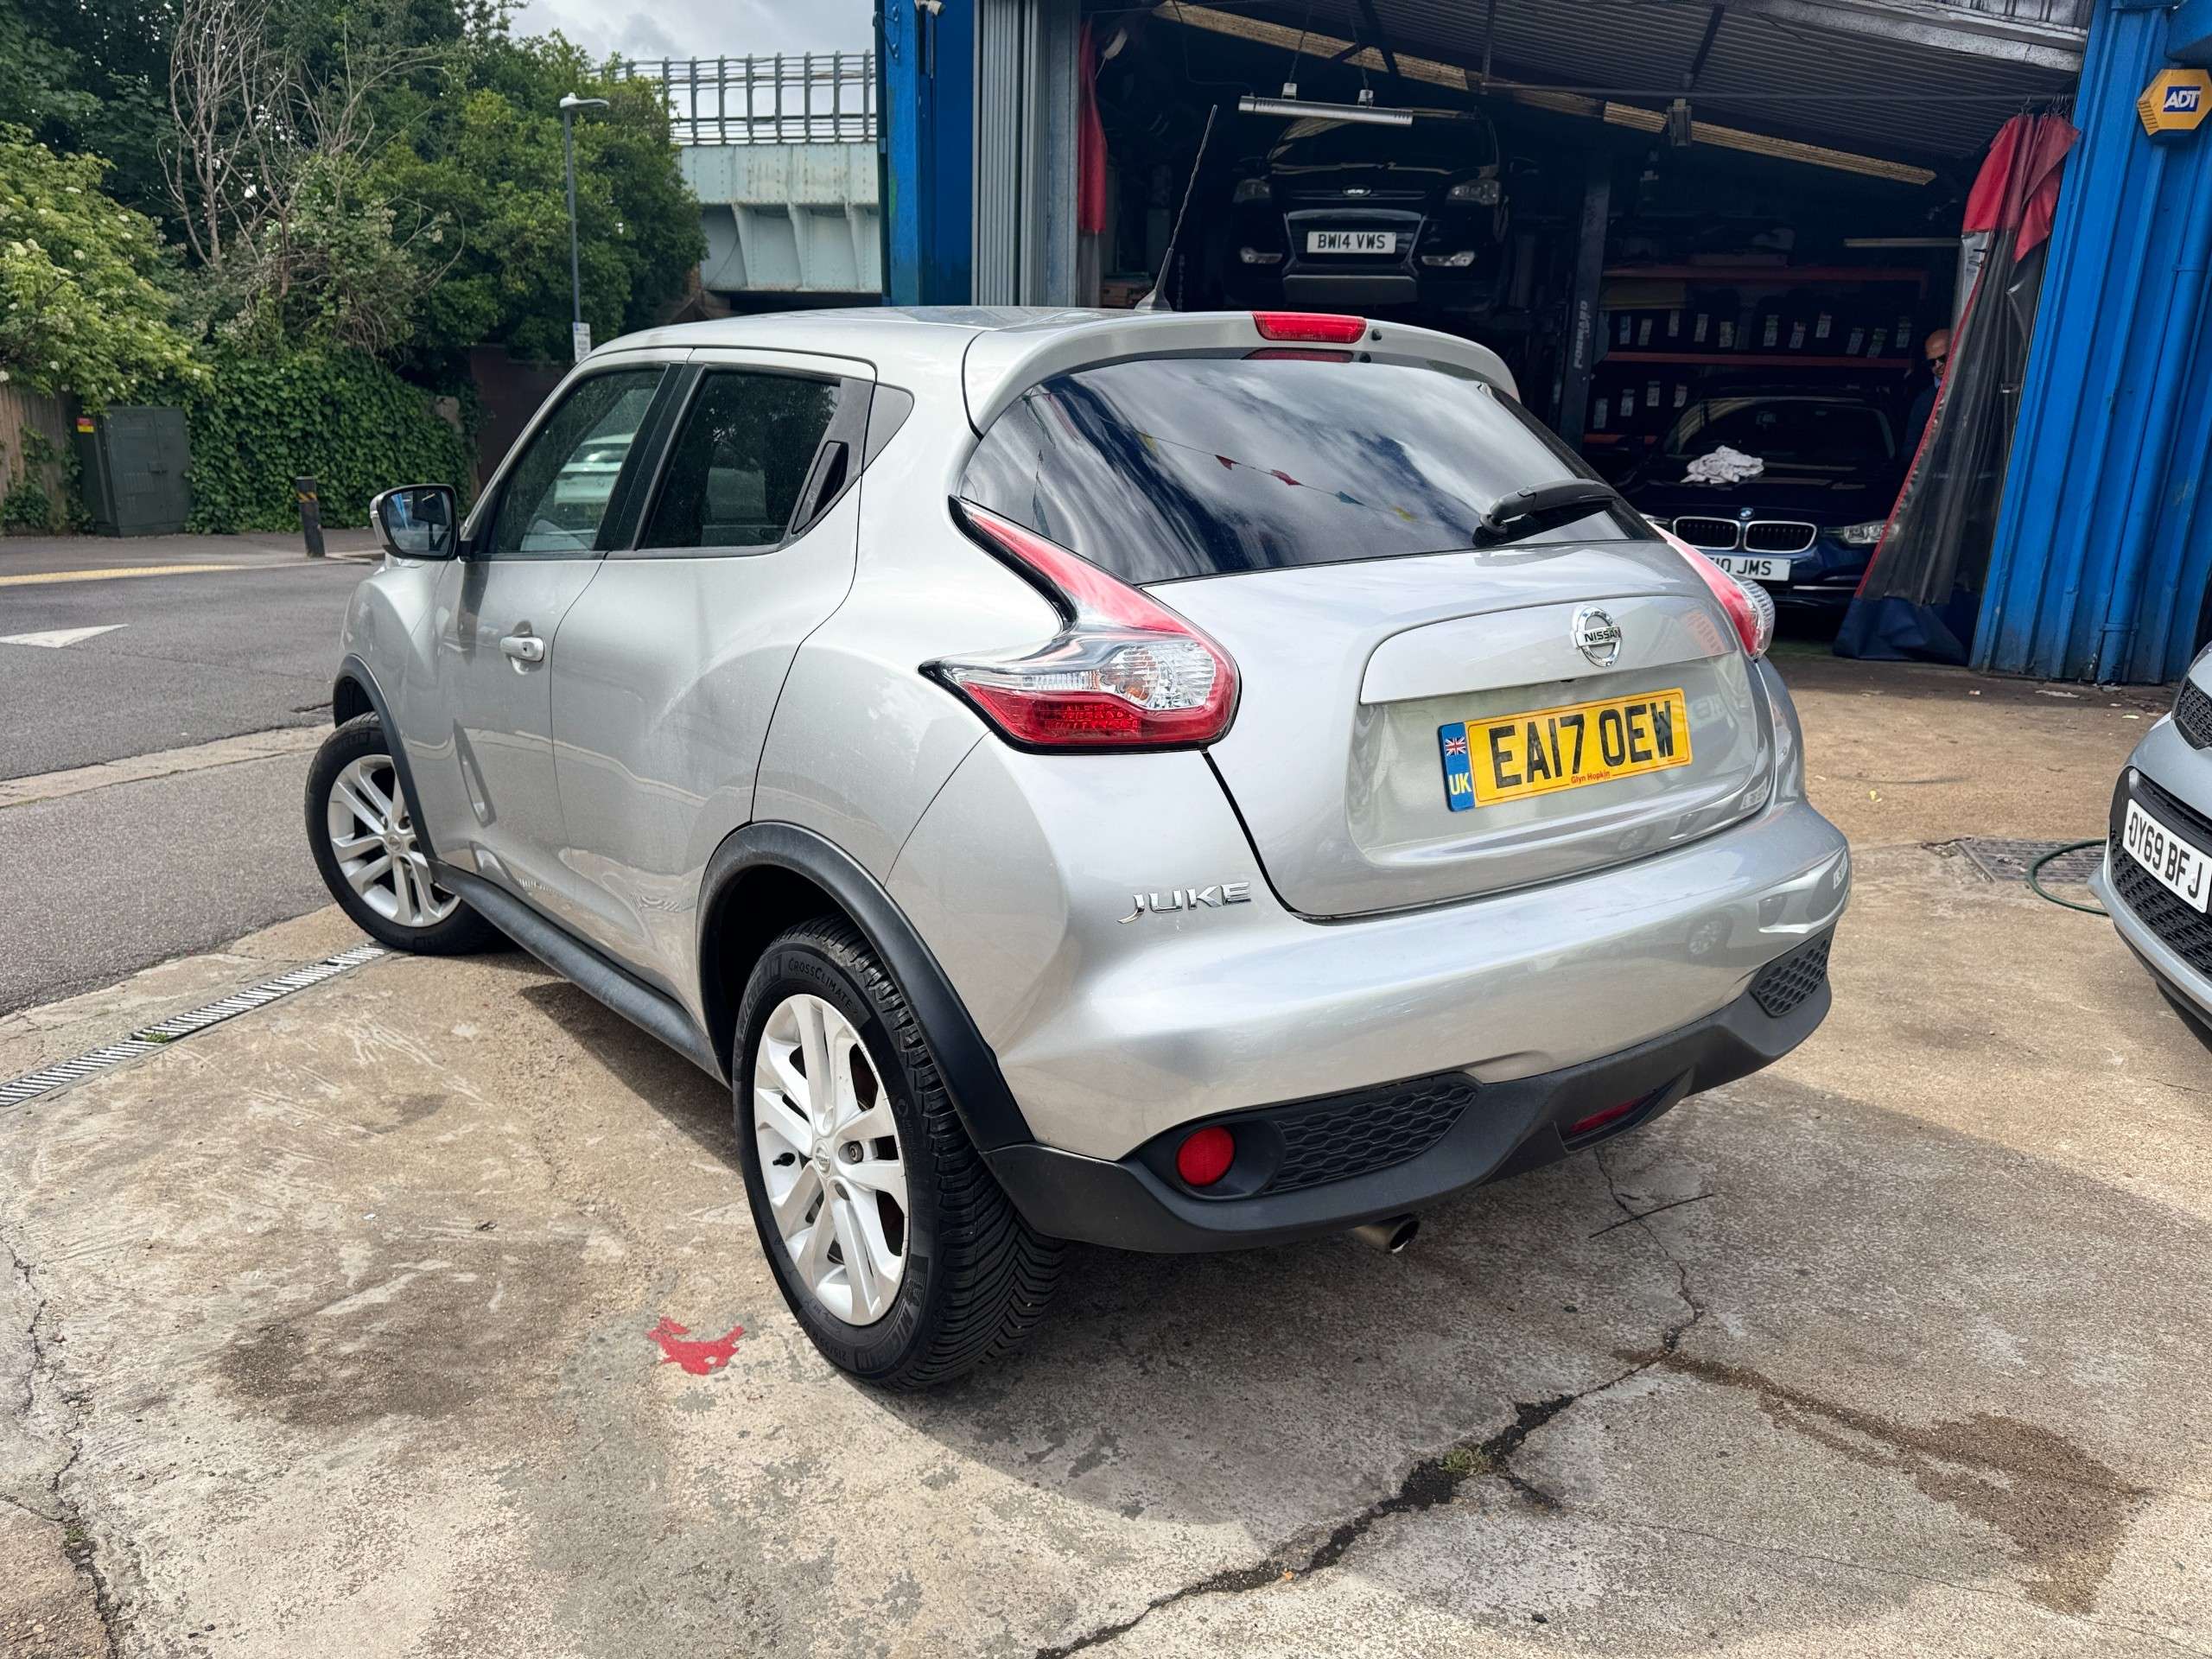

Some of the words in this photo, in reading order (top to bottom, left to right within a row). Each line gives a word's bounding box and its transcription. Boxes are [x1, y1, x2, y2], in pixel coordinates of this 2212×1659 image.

[2164, 90, 2201, 108] ADT
[1318, 234, 1351, 249] BW14
[1357, 234, 1386, 250] VWS
[1736, 559, 1772, 575] JMS
[1584, 628, 1621, 643] NISSAN
[1489, 714, 1585, 789] EA17
[1599, 700, 1674, 767] OEW
[1448, 772, 1471, 796] UK
[1571, 774, 1586, 784] Glyn
[1587, 771, 1611, 781] Hopkin
[2128, 810, 2164, 871] OY69
[2164, 841, 2203, 899] BFJ
[1117, 881, 1251, 925] JUKE
